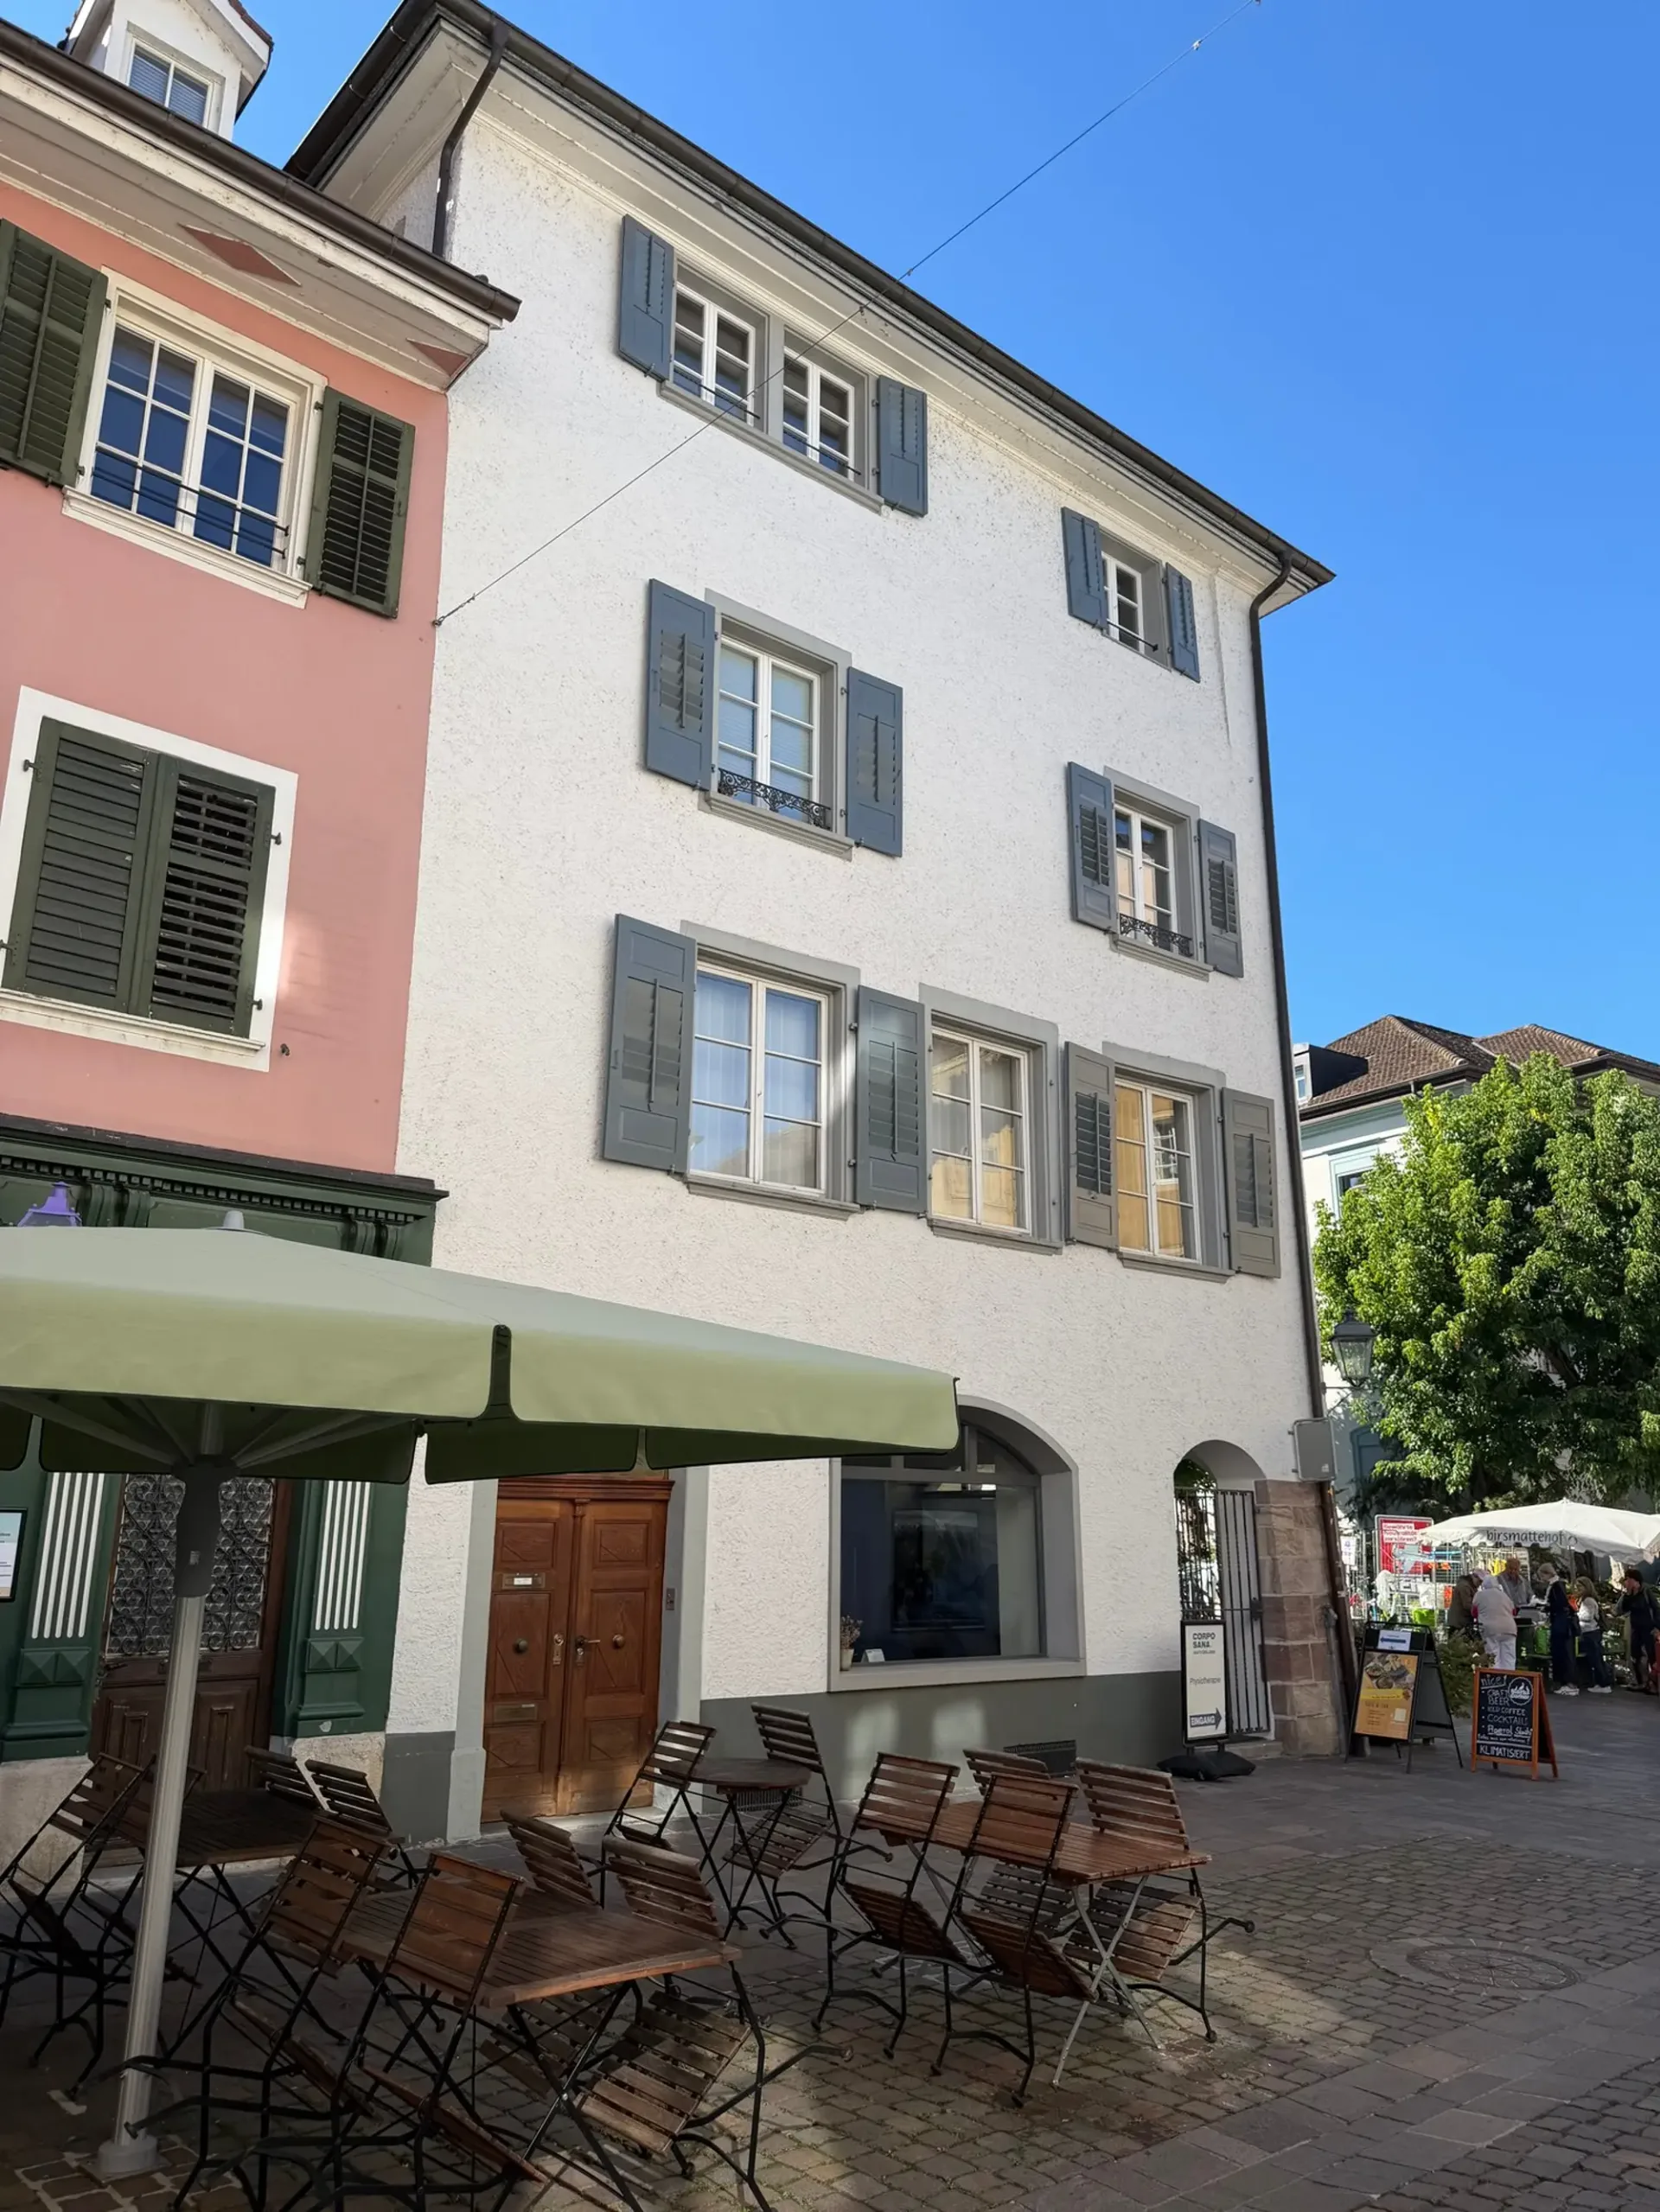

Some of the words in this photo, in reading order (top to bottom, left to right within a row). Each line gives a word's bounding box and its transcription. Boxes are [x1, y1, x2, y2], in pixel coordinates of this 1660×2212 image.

[1486, 1529, 1564, 1545] birsmattehof
[1488, 1695, 1510, 1706] BEER
[1501, 1707, 1526, 1716] COFFEE
[1191, 1715, 1216, 1726] EINGANG
[1479, 1744, 1530, 1760] KLIMATISIERT
